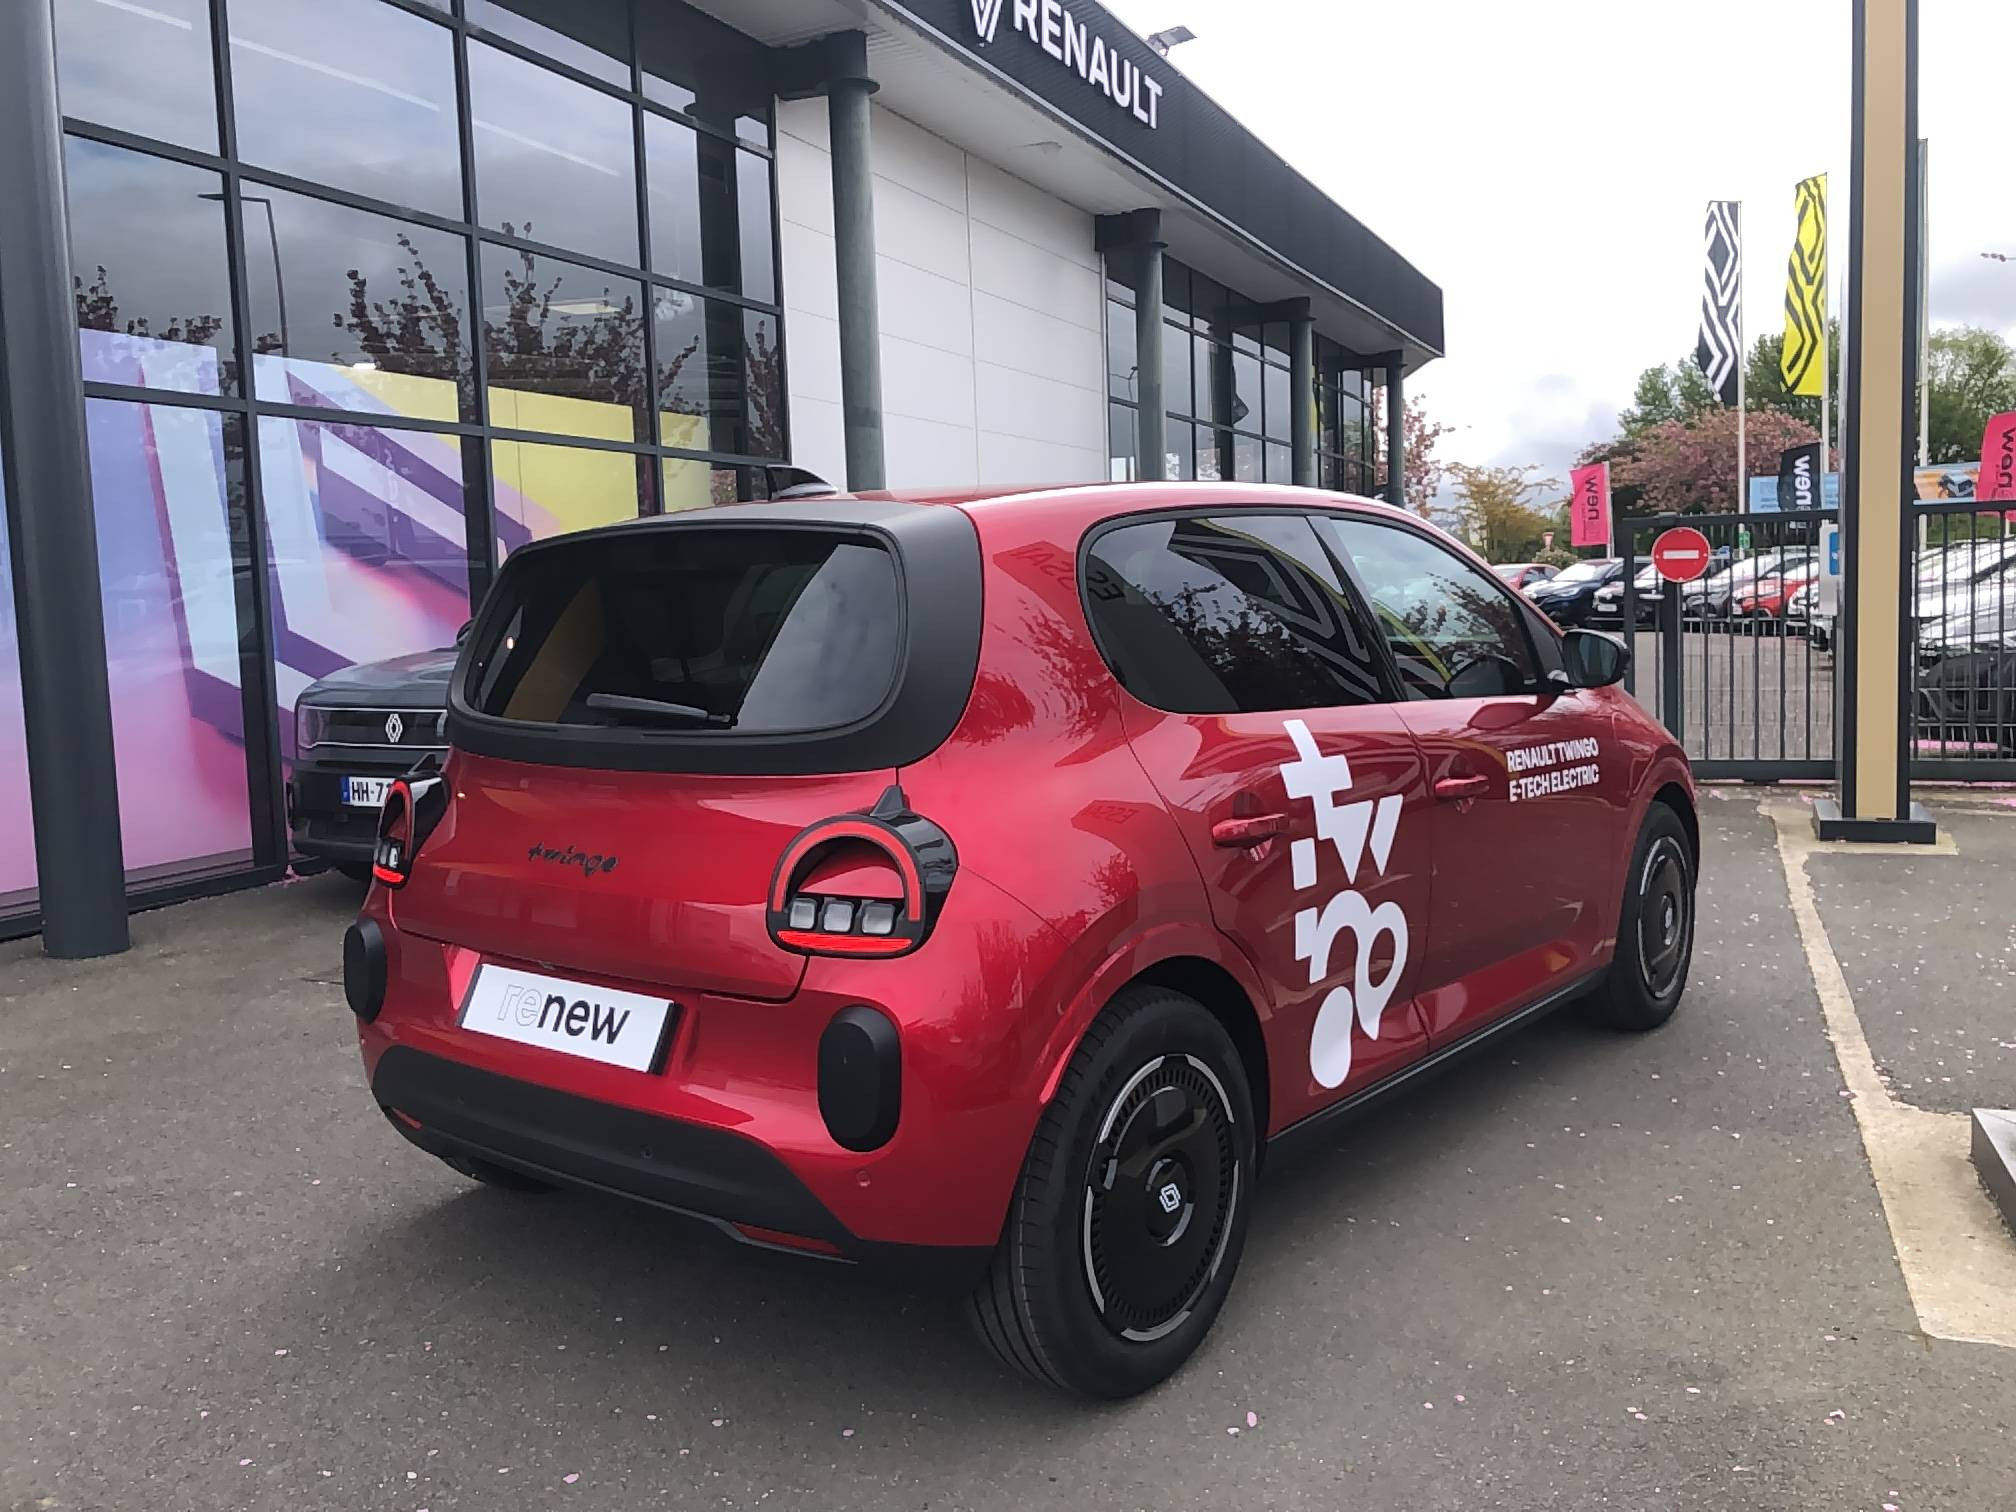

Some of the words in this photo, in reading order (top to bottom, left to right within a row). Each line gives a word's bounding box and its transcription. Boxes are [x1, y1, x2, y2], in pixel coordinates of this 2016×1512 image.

[1013, 0, 1163, 129] RENAULT
[1506, 744, 1557, 773] RENAULT
[1556, 737, 1599, 763] TWINGO
[351, 781, 393, 803] HH-7
[1509, 773, 1551, 803] E-TECH
[1550, 763, 1600, 793] ELECTRIC
[497, 983, 631, 1045] renew
